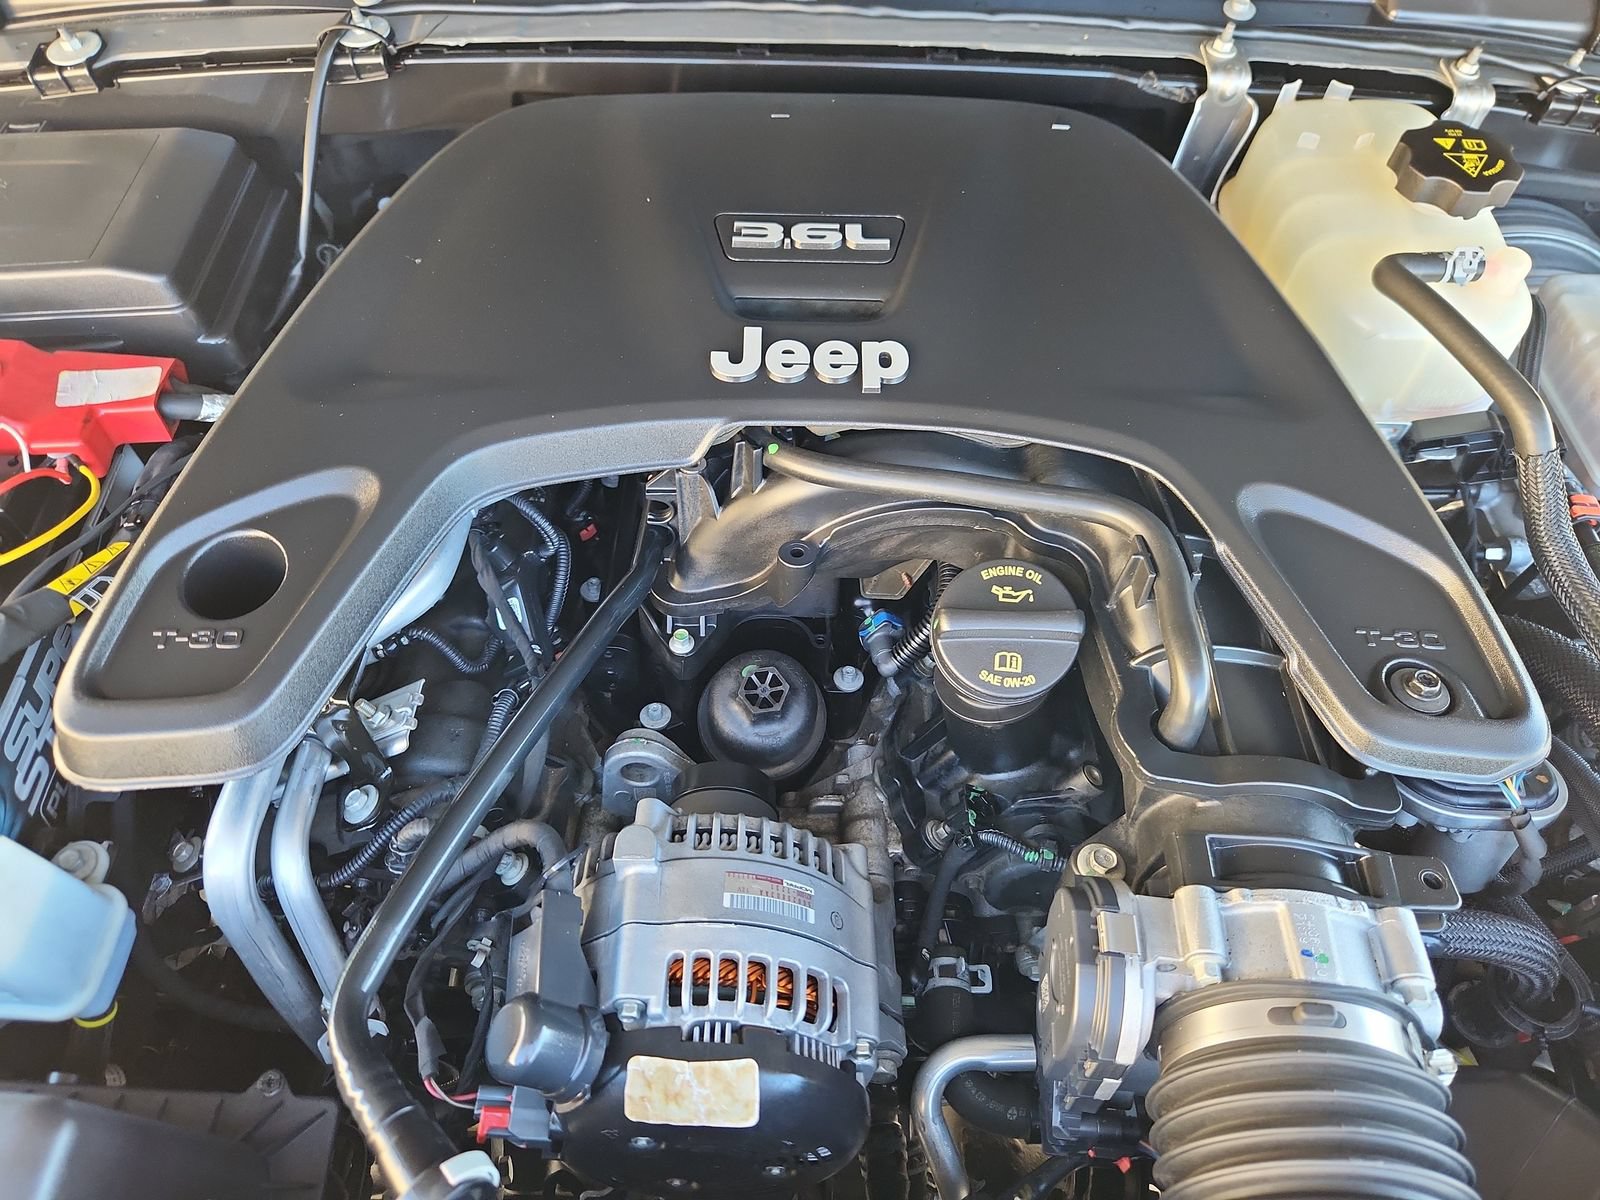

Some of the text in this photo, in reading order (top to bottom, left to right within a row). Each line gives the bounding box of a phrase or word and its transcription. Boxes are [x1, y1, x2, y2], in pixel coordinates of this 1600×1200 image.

[731, 221, 891, 250] 3.6L
[710, 326, 910, 394] Jeep
[980, 565, 1043, 585] ENGINE OIL
[152, 628, 245, 649] T-30
[1354, 627, 1447, 650] T-30
[978, 669, 1036, 688] SAE 0W-20
[4, 623, 72, 762] SUPE
